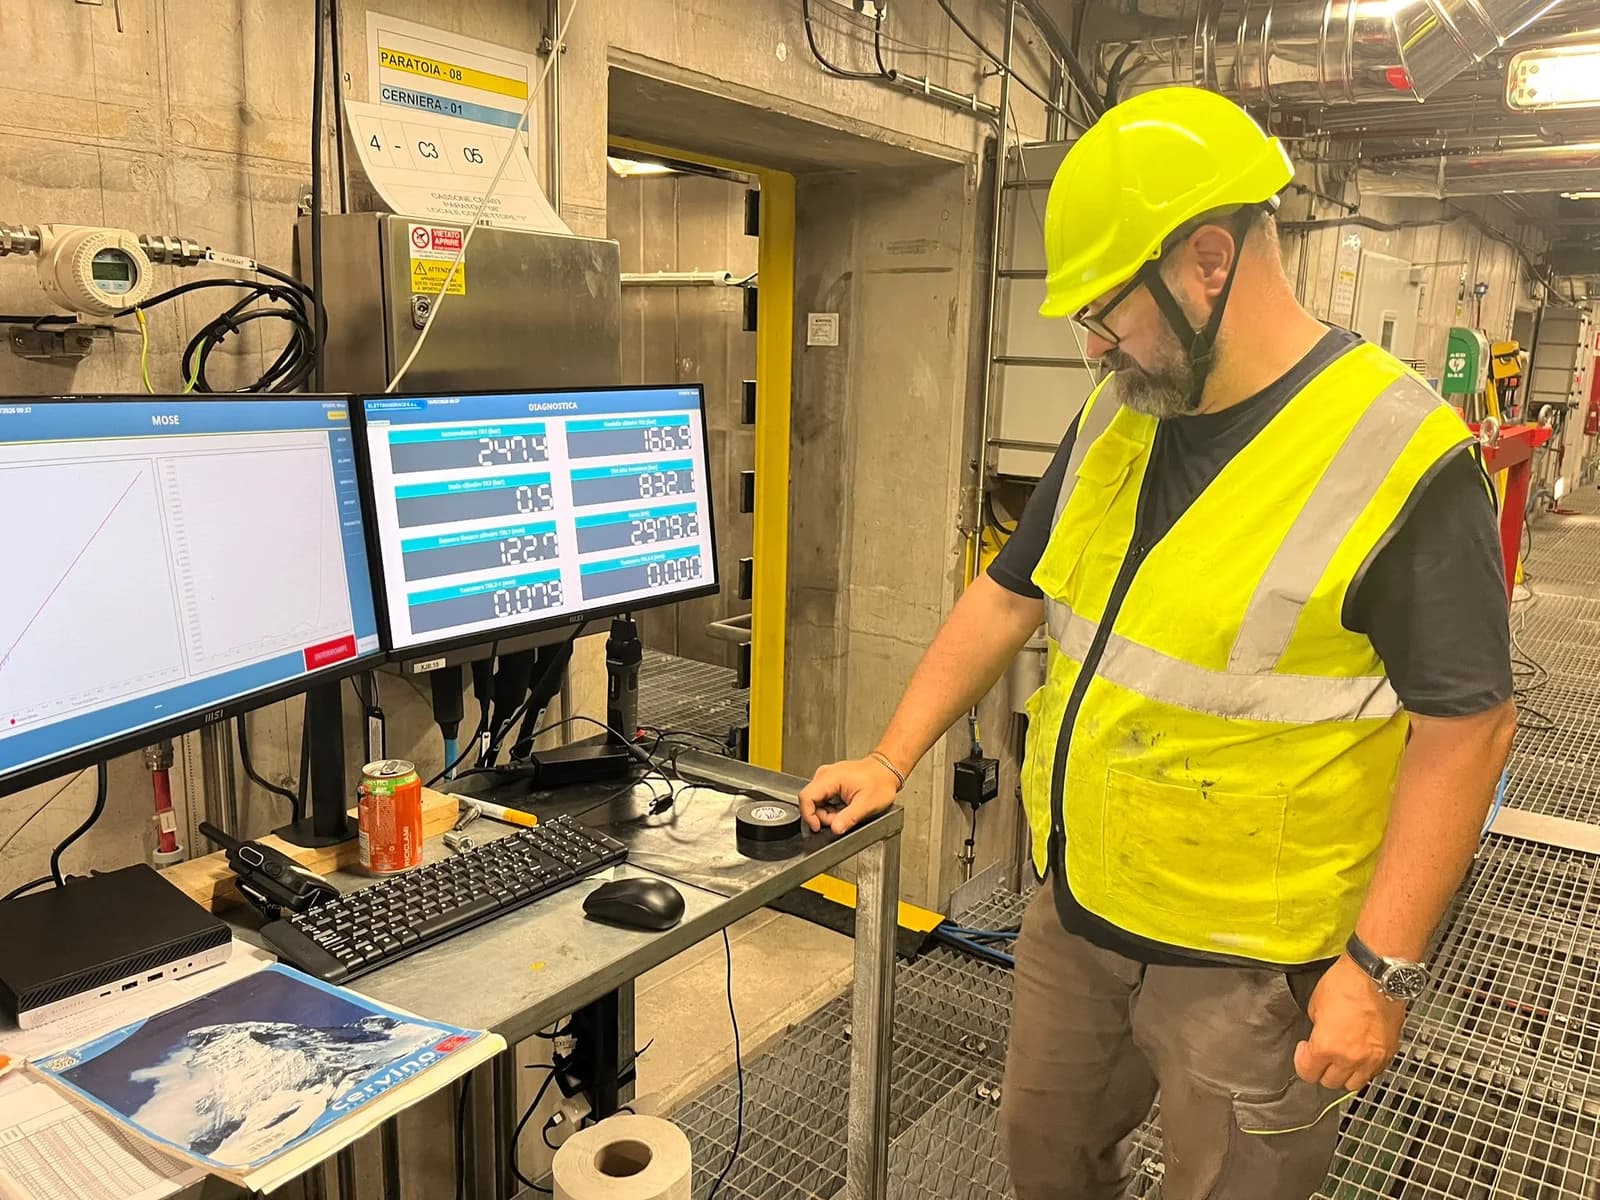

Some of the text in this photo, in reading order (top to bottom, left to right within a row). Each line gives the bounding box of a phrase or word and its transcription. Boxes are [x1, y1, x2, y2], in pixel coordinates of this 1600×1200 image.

[381, 52, 440, 75] PARATOIA
[449, 70, 462, 81] 08
[382, 89, 441, 110] CERNIERA
[450, 104, 463, 115] 01
[370, 135, 381, 151] 4
[418, 141, 438, 159] C3
[463, 147, 483, 164] 05
[433, 230, 460, 239] VIETATO
[152, 415, 180, 426] MOSE
[528, 402, 578, 411] DIAGNOSTICA
[479, 436, 548, 466] 247.4
[516, 484, 553, 513] 0.5
[639, 471, 695, 498] 832.1
[631, 513, 699, 545] 2979.2
[500, 532, 558, 565] 122.7
[647, 556, 702, 587] 0.000
[494, 580, 563, 617] 0.079
[205, 709, 223, 723] MSI
[331, 1052, 436, 1112] cervino
